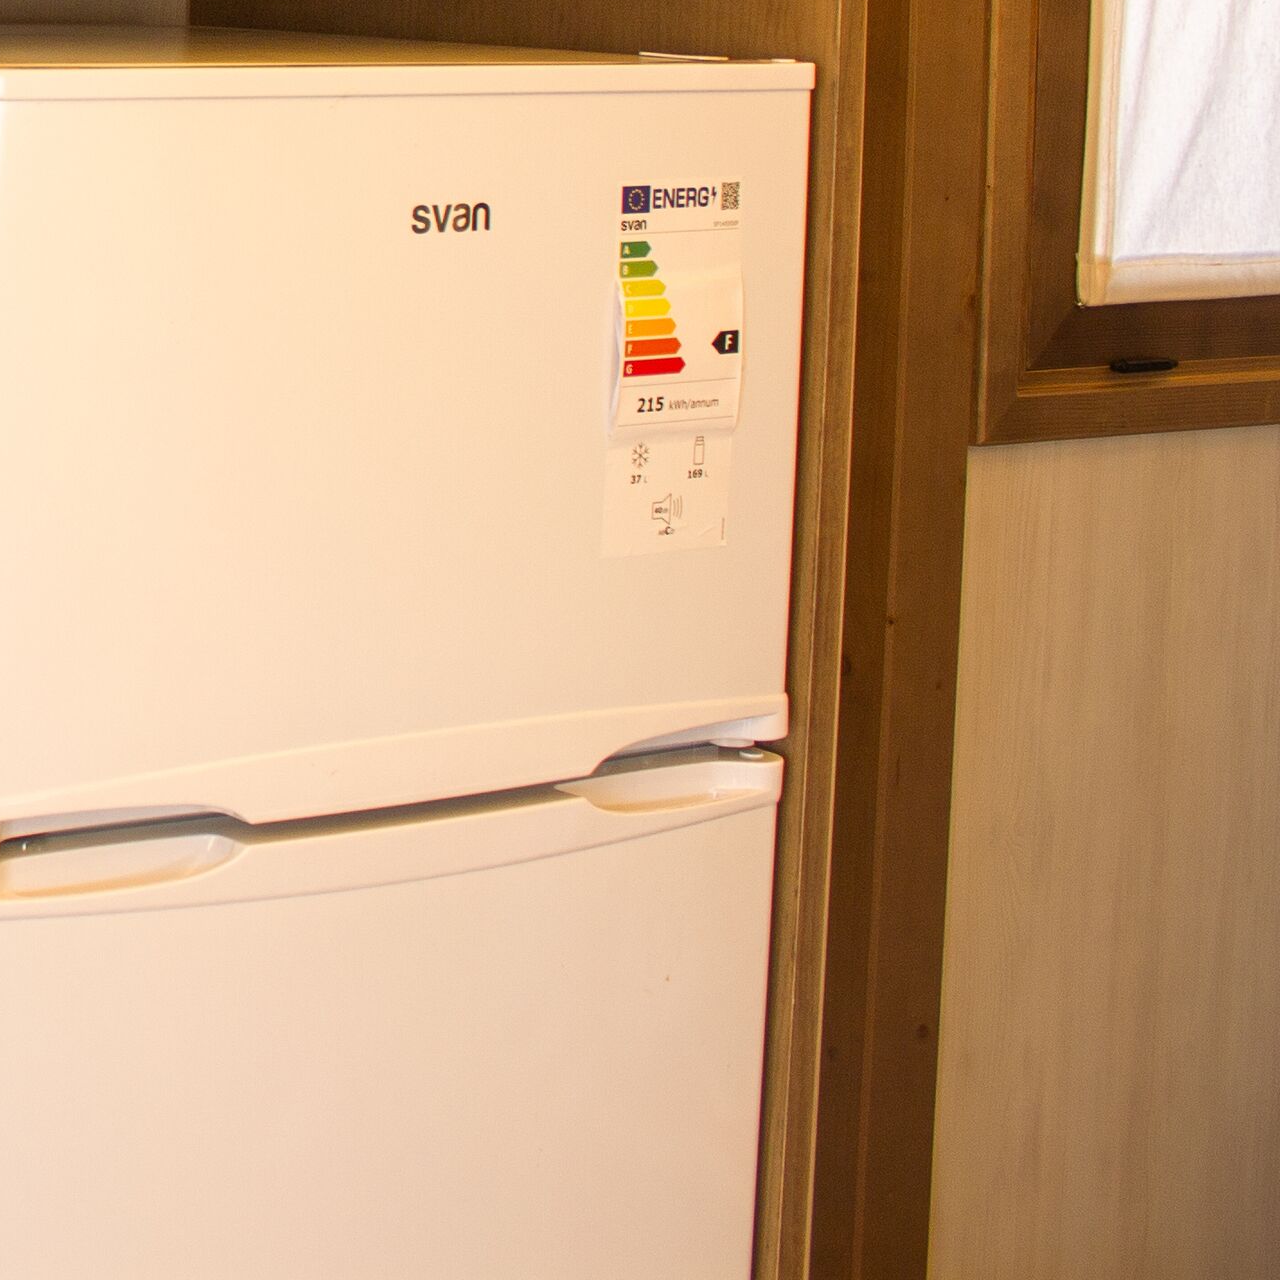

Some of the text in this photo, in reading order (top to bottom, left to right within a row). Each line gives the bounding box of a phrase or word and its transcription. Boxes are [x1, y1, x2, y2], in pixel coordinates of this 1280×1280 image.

[652, 187, 710, 210] ENERG
[411, 202, 491, 235] svan
[621, 219, 647, 232] svan
[725, 334, 734, 351] F
[626, 364, 634, 375] G
[637, 396, 720, 413] 215 kWh/annum
[630, 475, 642, 485] 37
